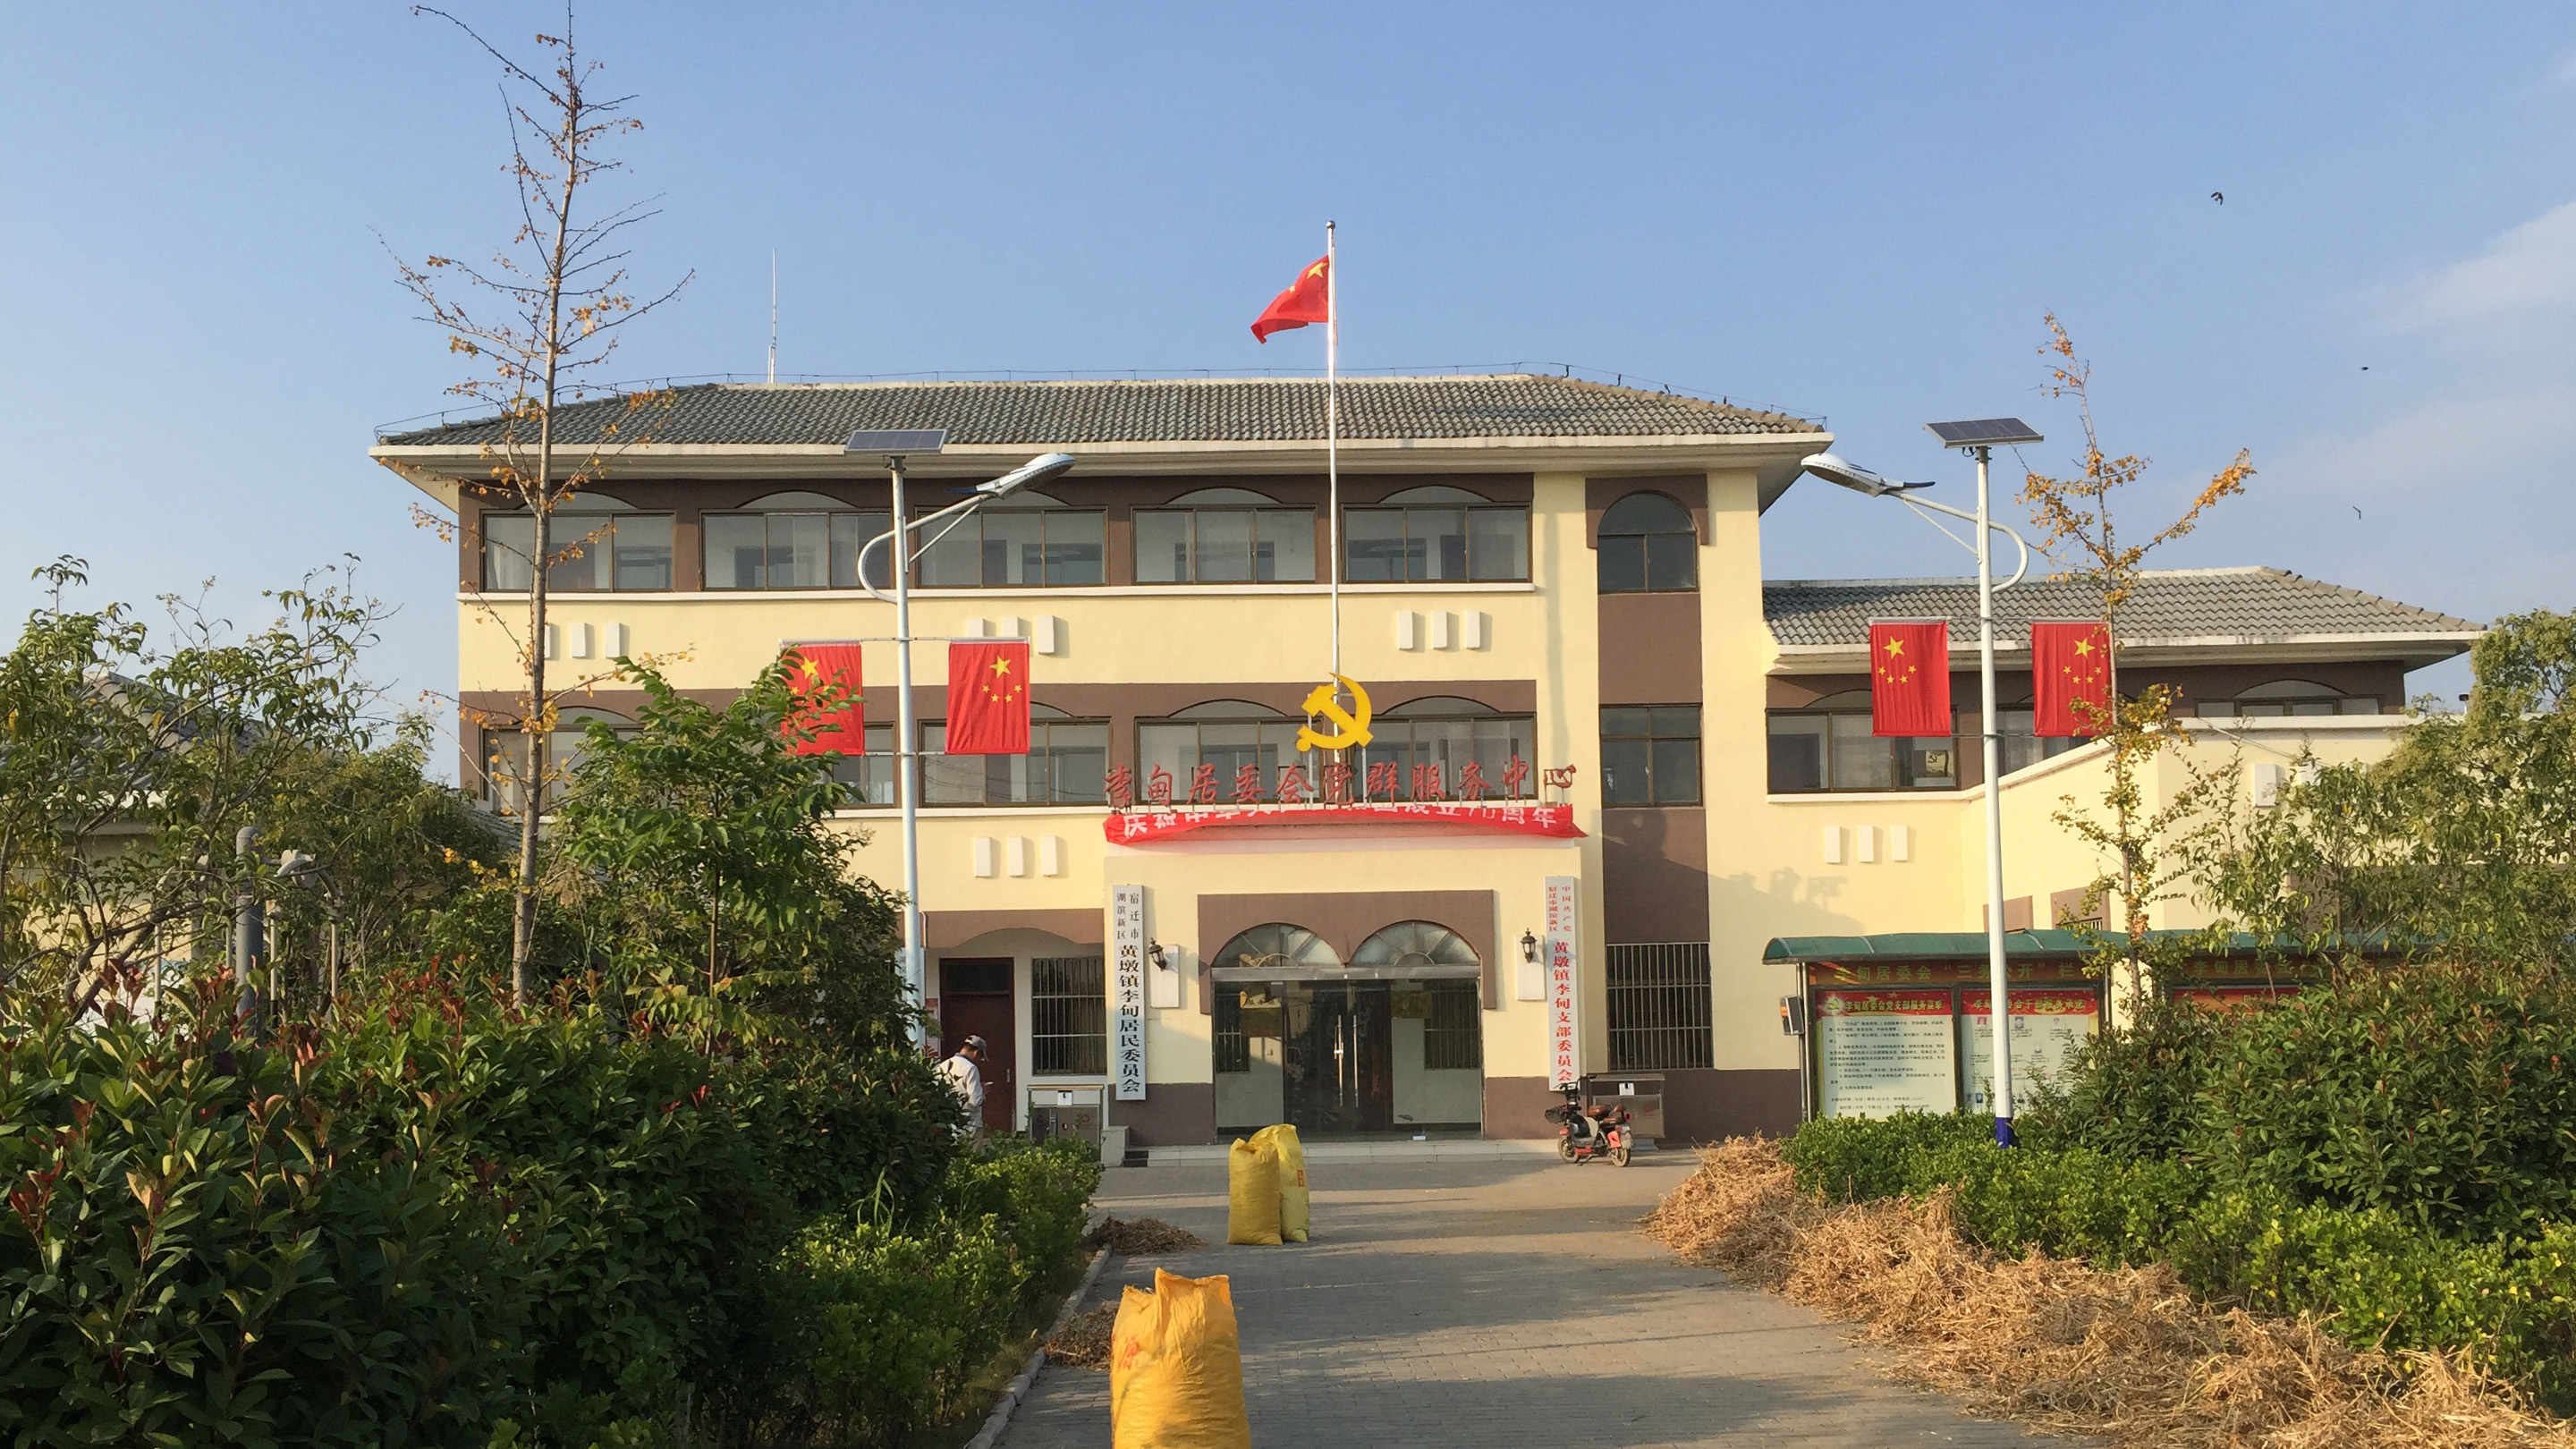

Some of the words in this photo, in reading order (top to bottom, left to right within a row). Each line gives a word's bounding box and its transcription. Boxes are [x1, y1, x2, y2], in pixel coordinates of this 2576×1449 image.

[1116, 893, 1127, 940] 湖滨新区
[1130, 893, 1140, 939] 宿迁市
[1119, 945, 1141, 1093] 黄墩镇李甸居民委员会
[1554, 941, 1572, 1081] 黄墩镇李甸支部委员会
